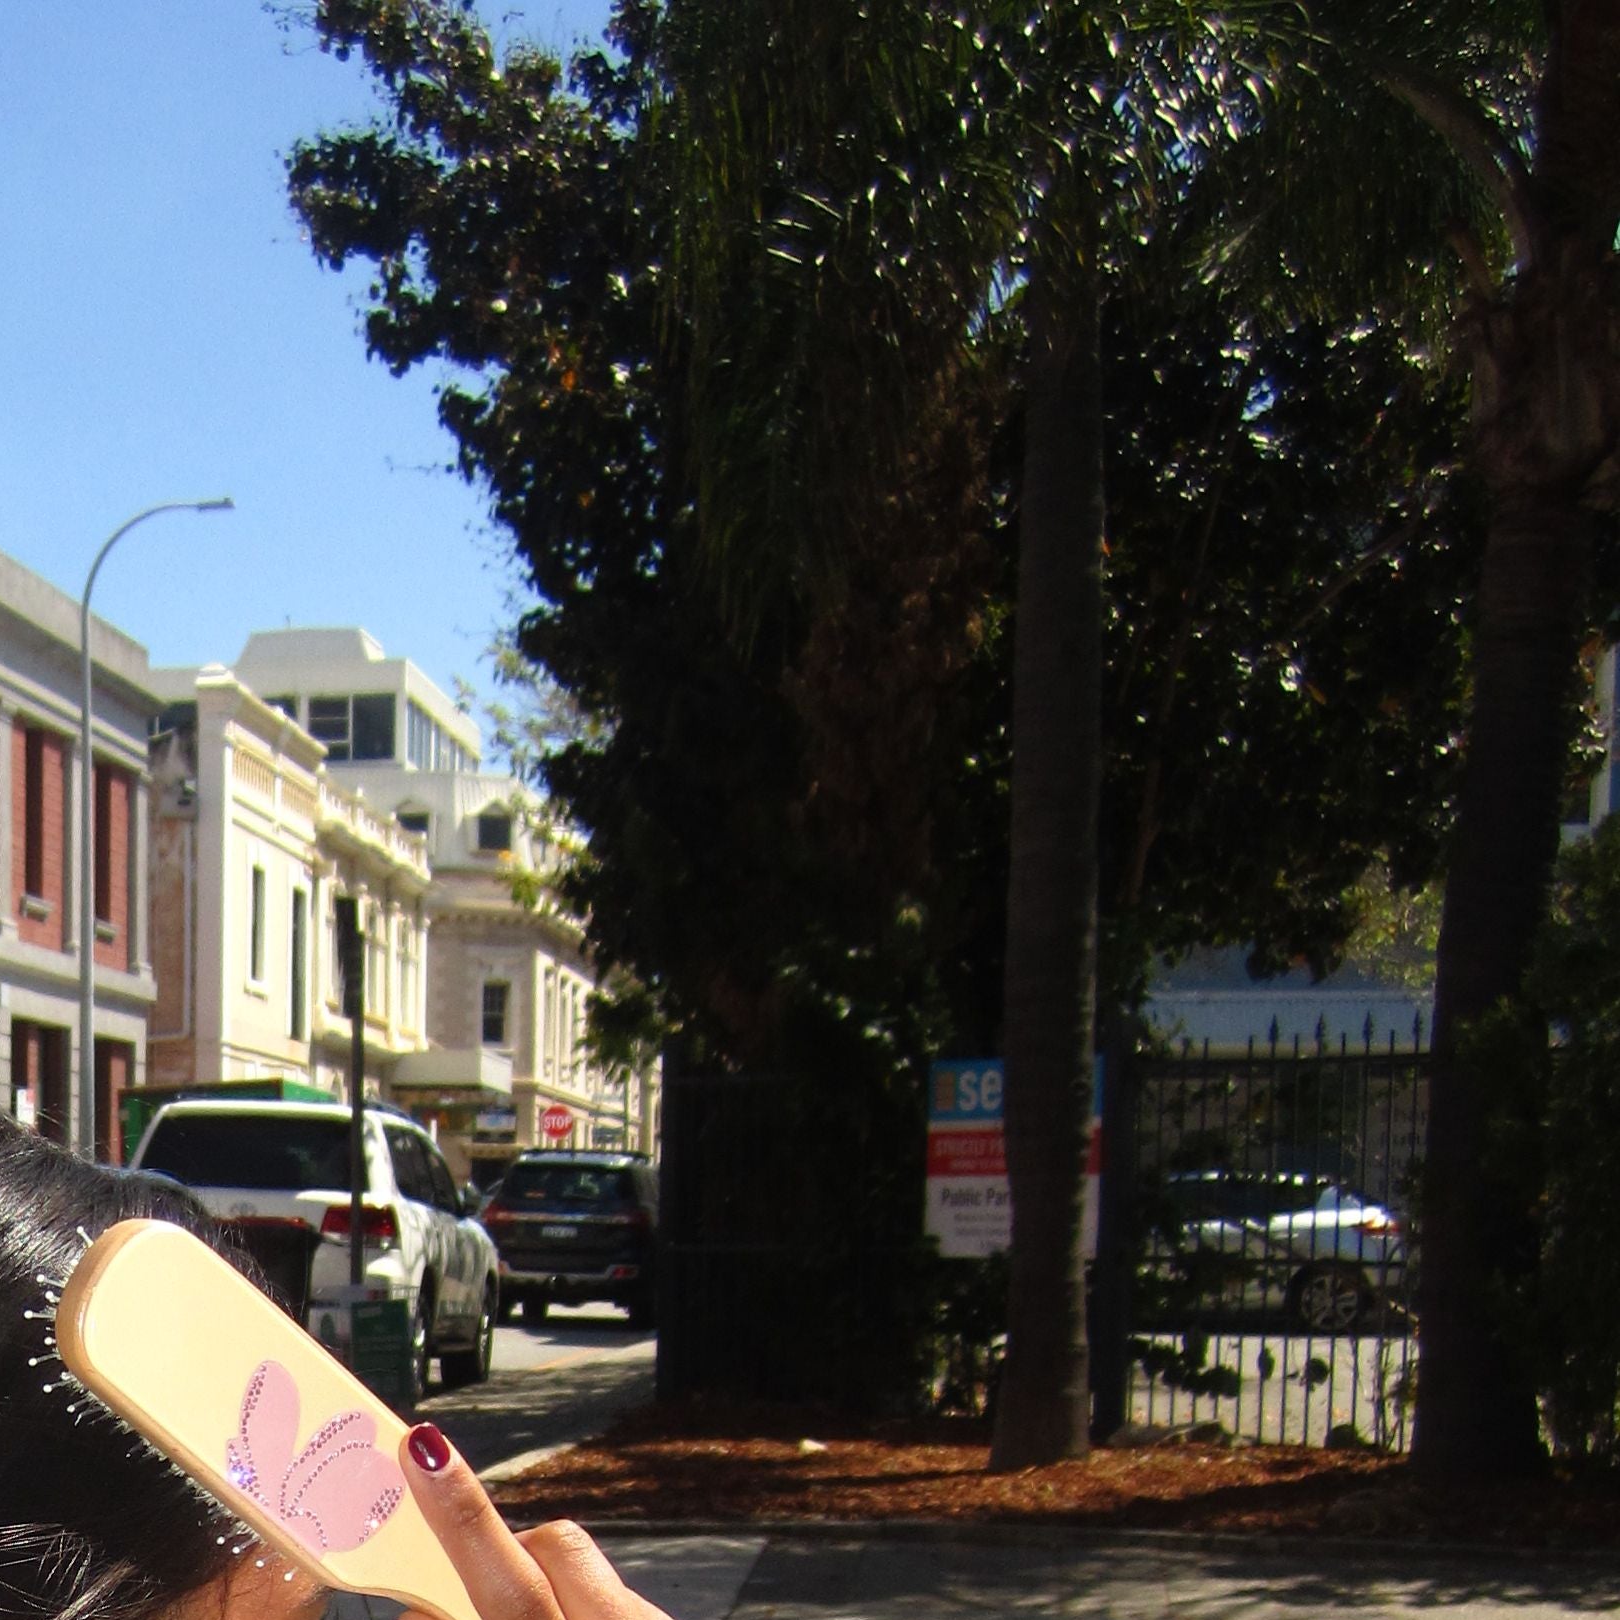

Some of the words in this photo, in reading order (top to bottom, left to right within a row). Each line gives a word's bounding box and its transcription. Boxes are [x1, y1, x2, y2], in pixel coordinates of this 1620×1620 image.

[959, 1069, 1003, 1111] se
[543, 1115, 572, 1129] STOP
[941, 1187, 981, 1206] Public
